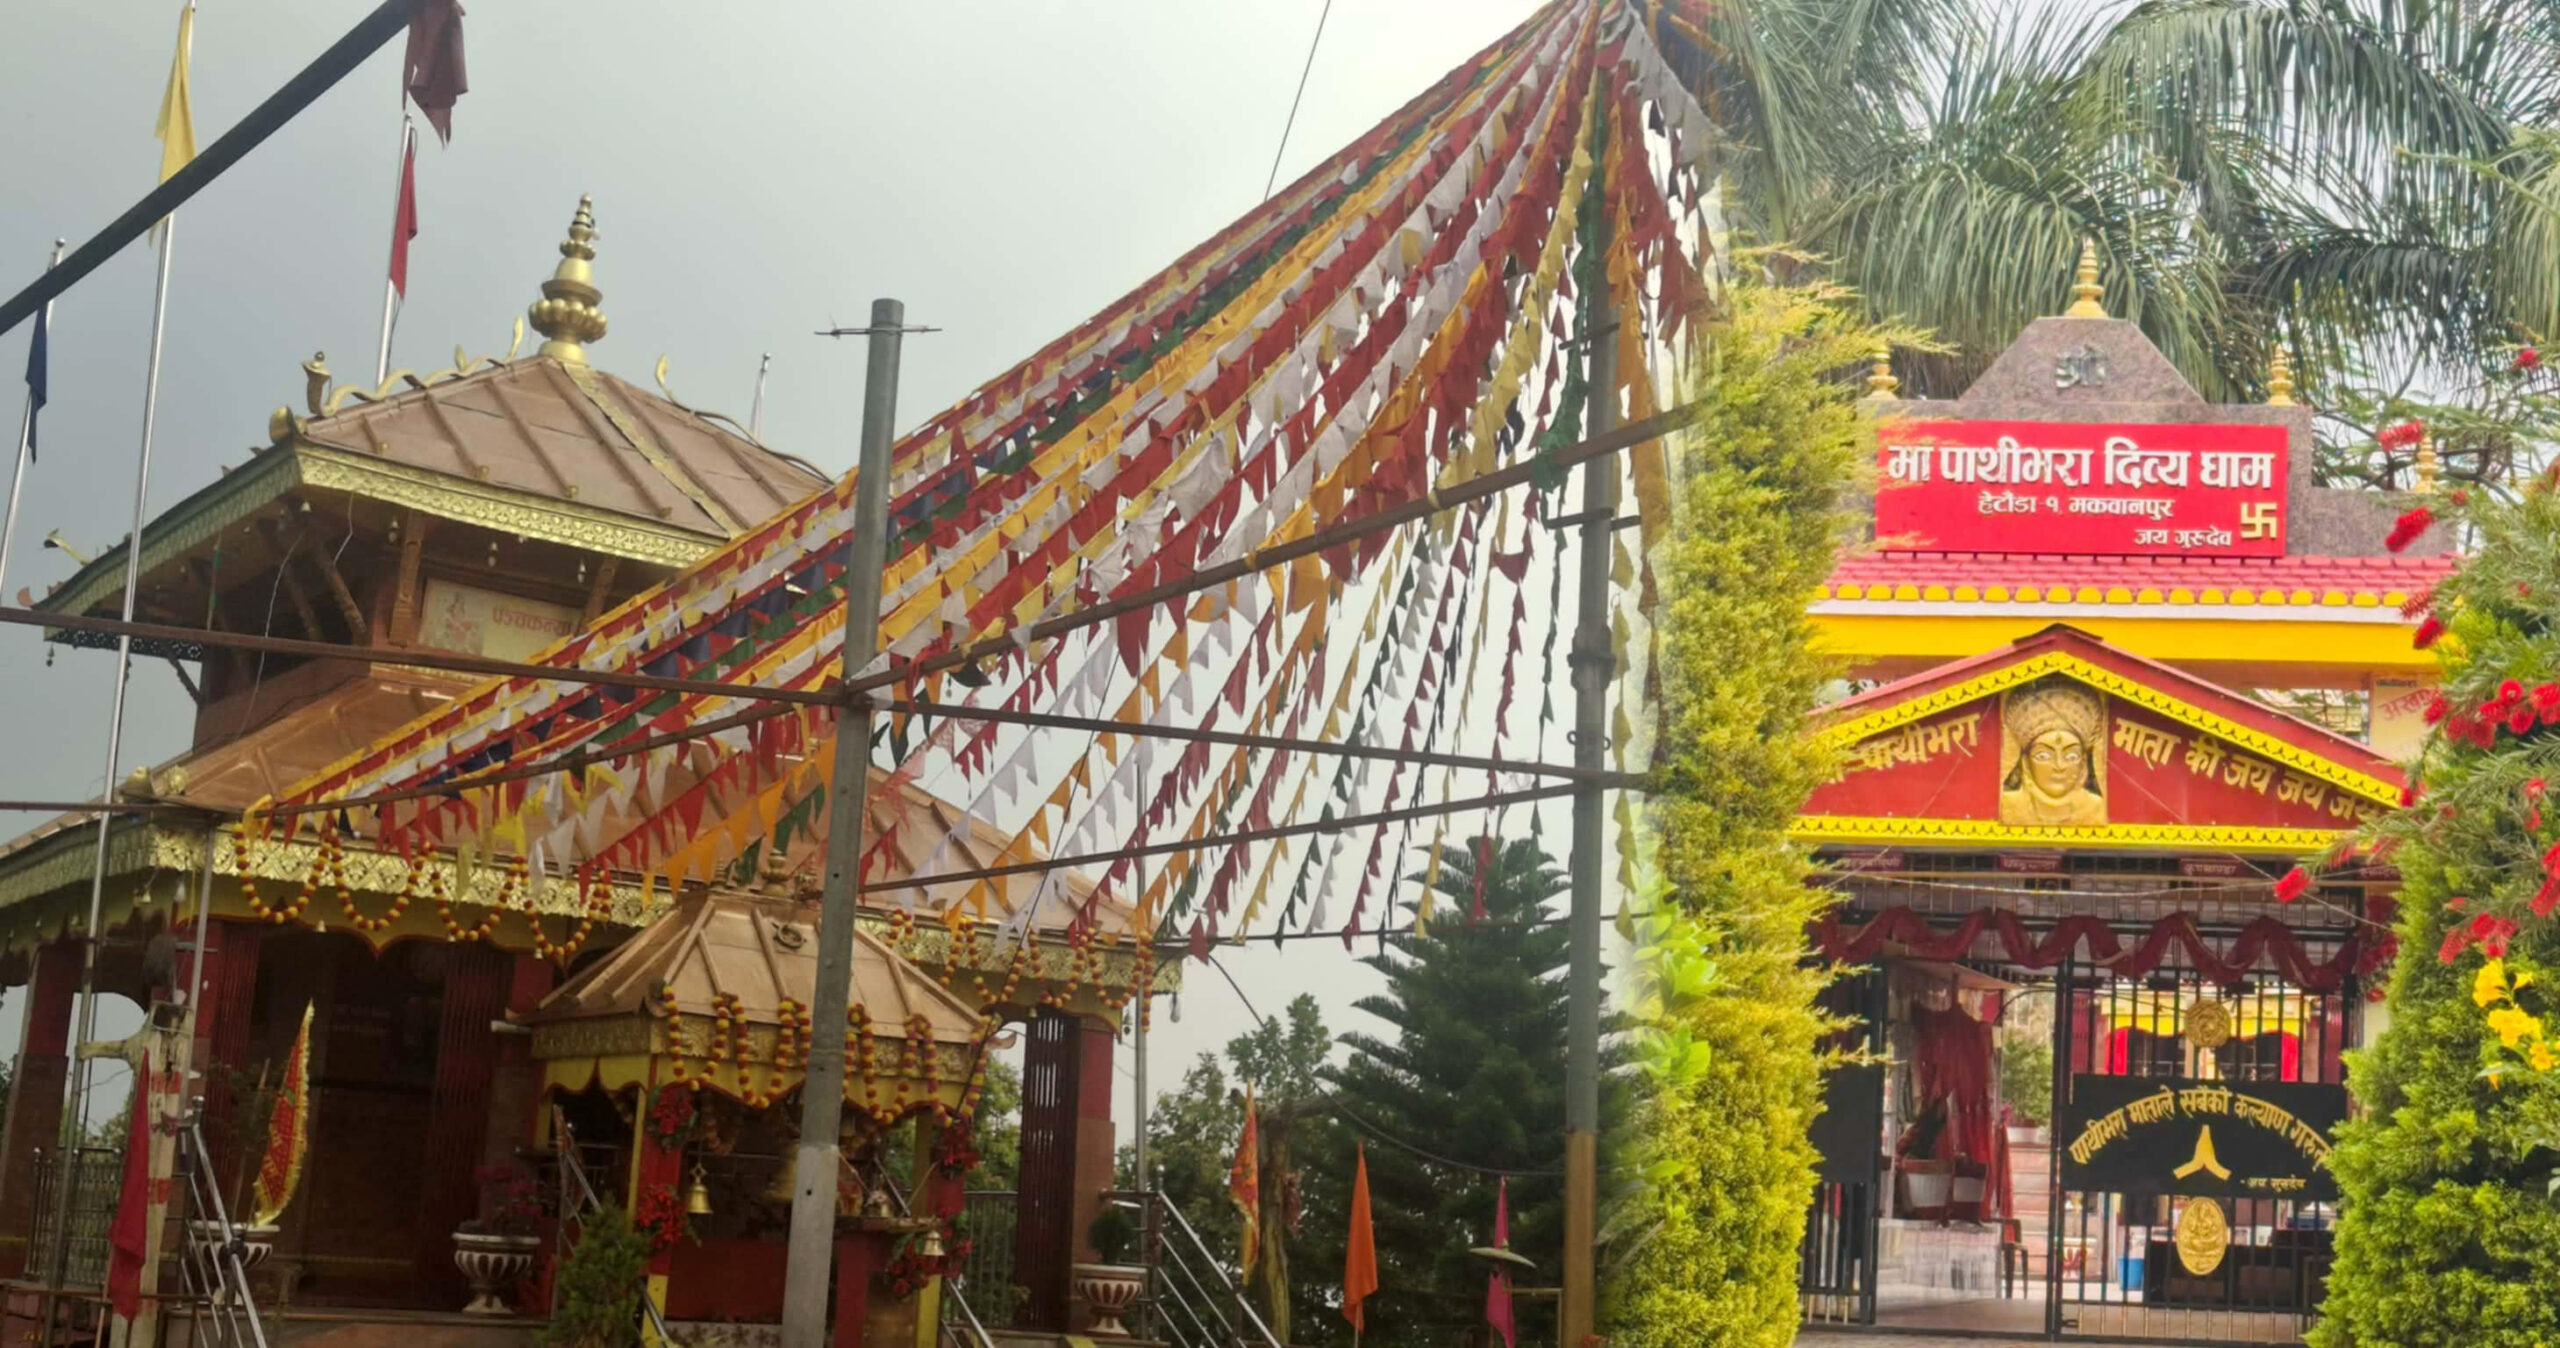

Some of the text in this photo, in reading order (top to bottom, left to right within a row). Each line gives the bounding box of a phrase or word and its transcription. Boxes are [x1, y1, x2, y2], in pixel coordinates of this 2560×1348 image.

[1939, 435, 2094, 487] पाथीभरा
[2104, 436, 2191, 489] दिव्य
[2069, 497, 2175, 520] मकवानपुर
[2134, 529, 2168, 545] जय
[2113, 717, 2181, 771] माता
[2185, 735, 2226, 779] की
[2224, 753, 2276, 795] जय
[2277, 768, 2330, 811] जय
[2068, 1118, 2128, 1165] पाथीभरा
[2125, 1084, 2175, 1123] माताले
[2233, 1093, 2294, 1138] कल्याण
